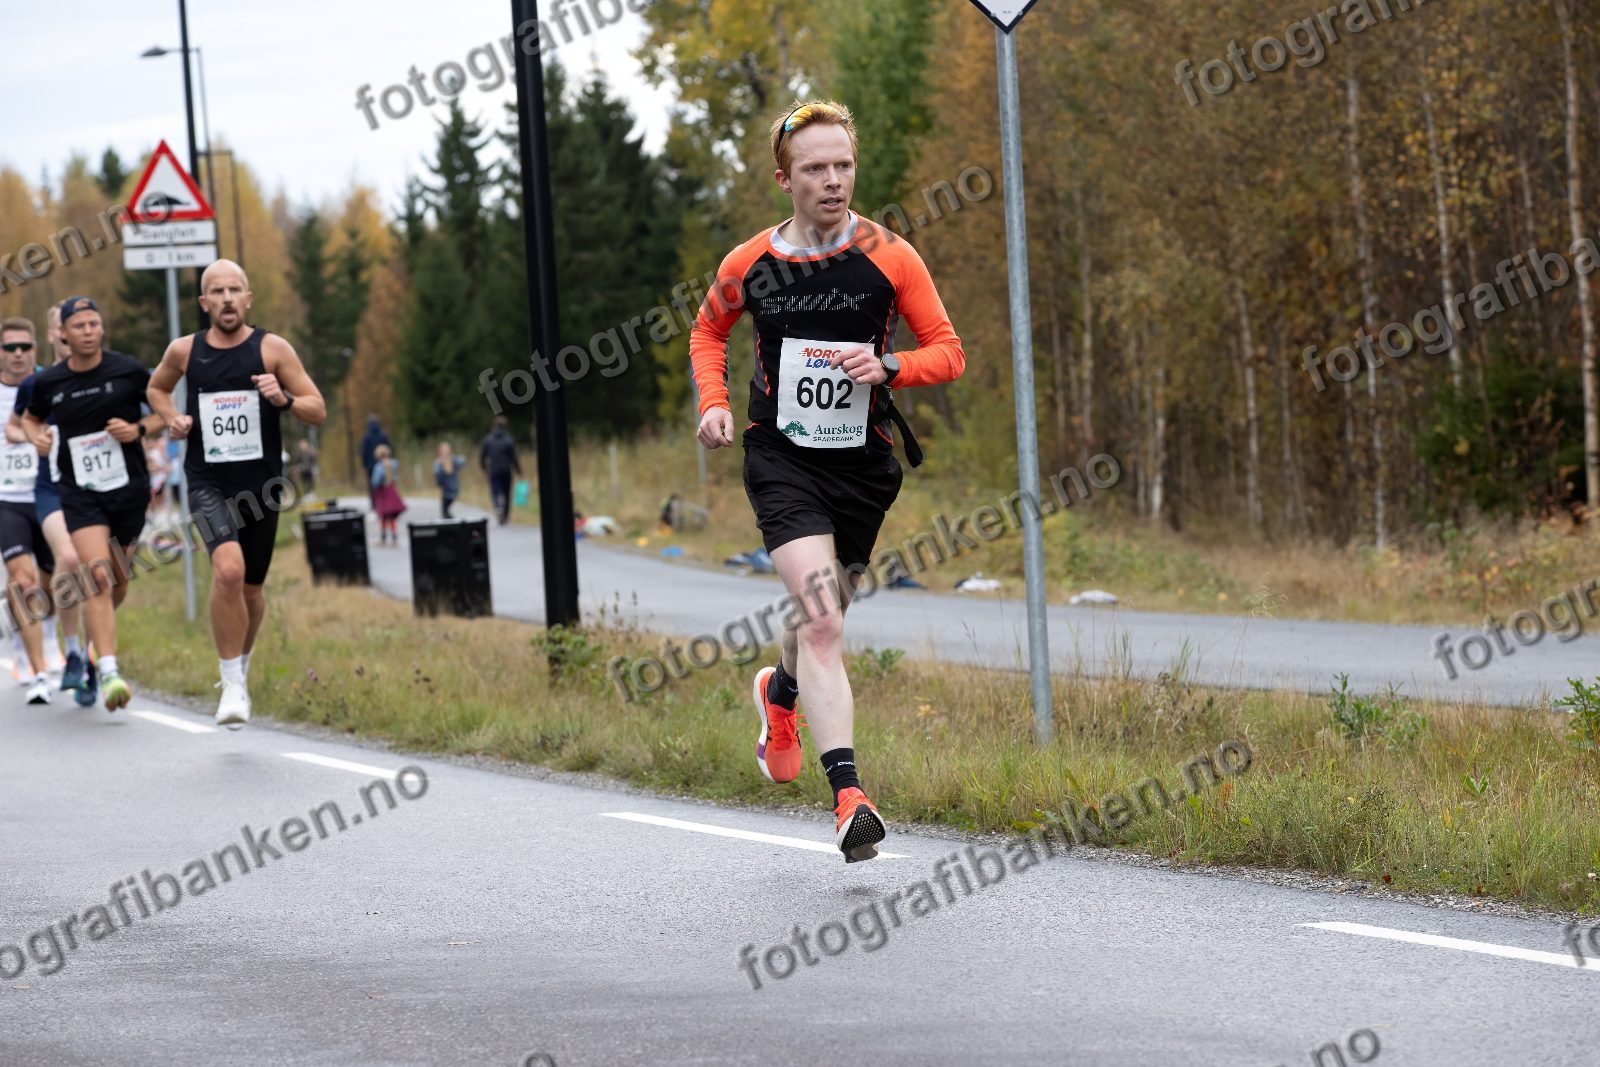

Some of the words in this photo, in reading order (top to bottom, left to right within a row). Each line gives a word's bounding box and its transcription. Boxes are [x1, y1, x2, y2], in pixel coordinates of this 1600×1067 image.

[806, 358, 832, 369] LØP
[797, 376, 854, 410] 602
[213, 414, 248, 436] 640
[815, 423, 863, 436] Aurskog
[5, 454, 32, 470] 783
[82, 450, 111, 472] 917
